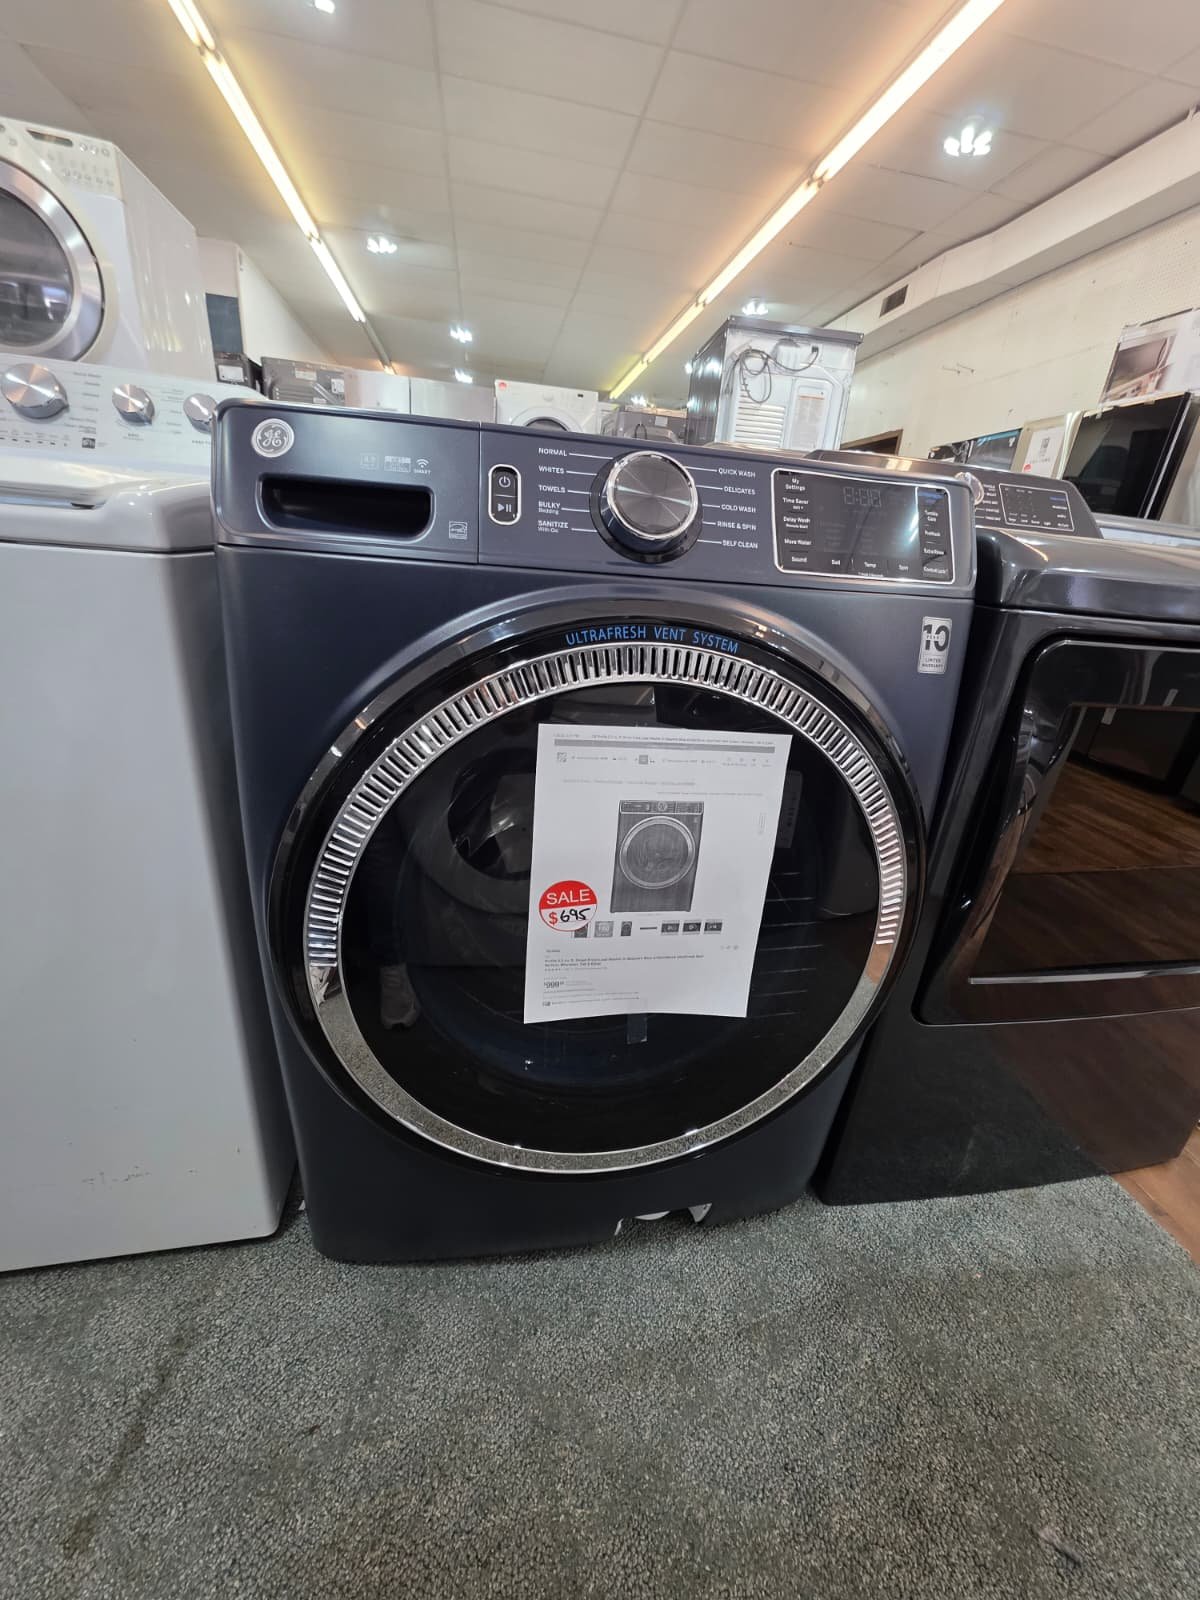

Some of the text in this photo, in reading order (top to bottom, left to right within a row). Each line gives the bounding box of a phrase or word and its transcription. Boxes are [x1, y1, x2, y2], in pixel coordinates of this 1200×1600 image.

[538, 447, 568, 457] NORMAL
[538, 465, 565, 474] WHITES
[718, 468, 756, 478] QUICK WASH
[538, 485, 566, 494] TOWELS
[723, 487, 756, 496] DELICATES
[785, 483, 806, 492] Settings
[538, 501, 561, 510] BULKY
[721, 504, 756, 513] COLD WASH
[537, 519, 569, 529] SANITIZE
[717, 520, 757, 531] RINSE & SPIN
[722, 540, 758, 549] SELF CLEAN
[565, 625, 739, 655] ULTRAFRESH VENT SYSTEM
[923, 624, 950, 652] 10
[546, 888, 590, 905] SALE
